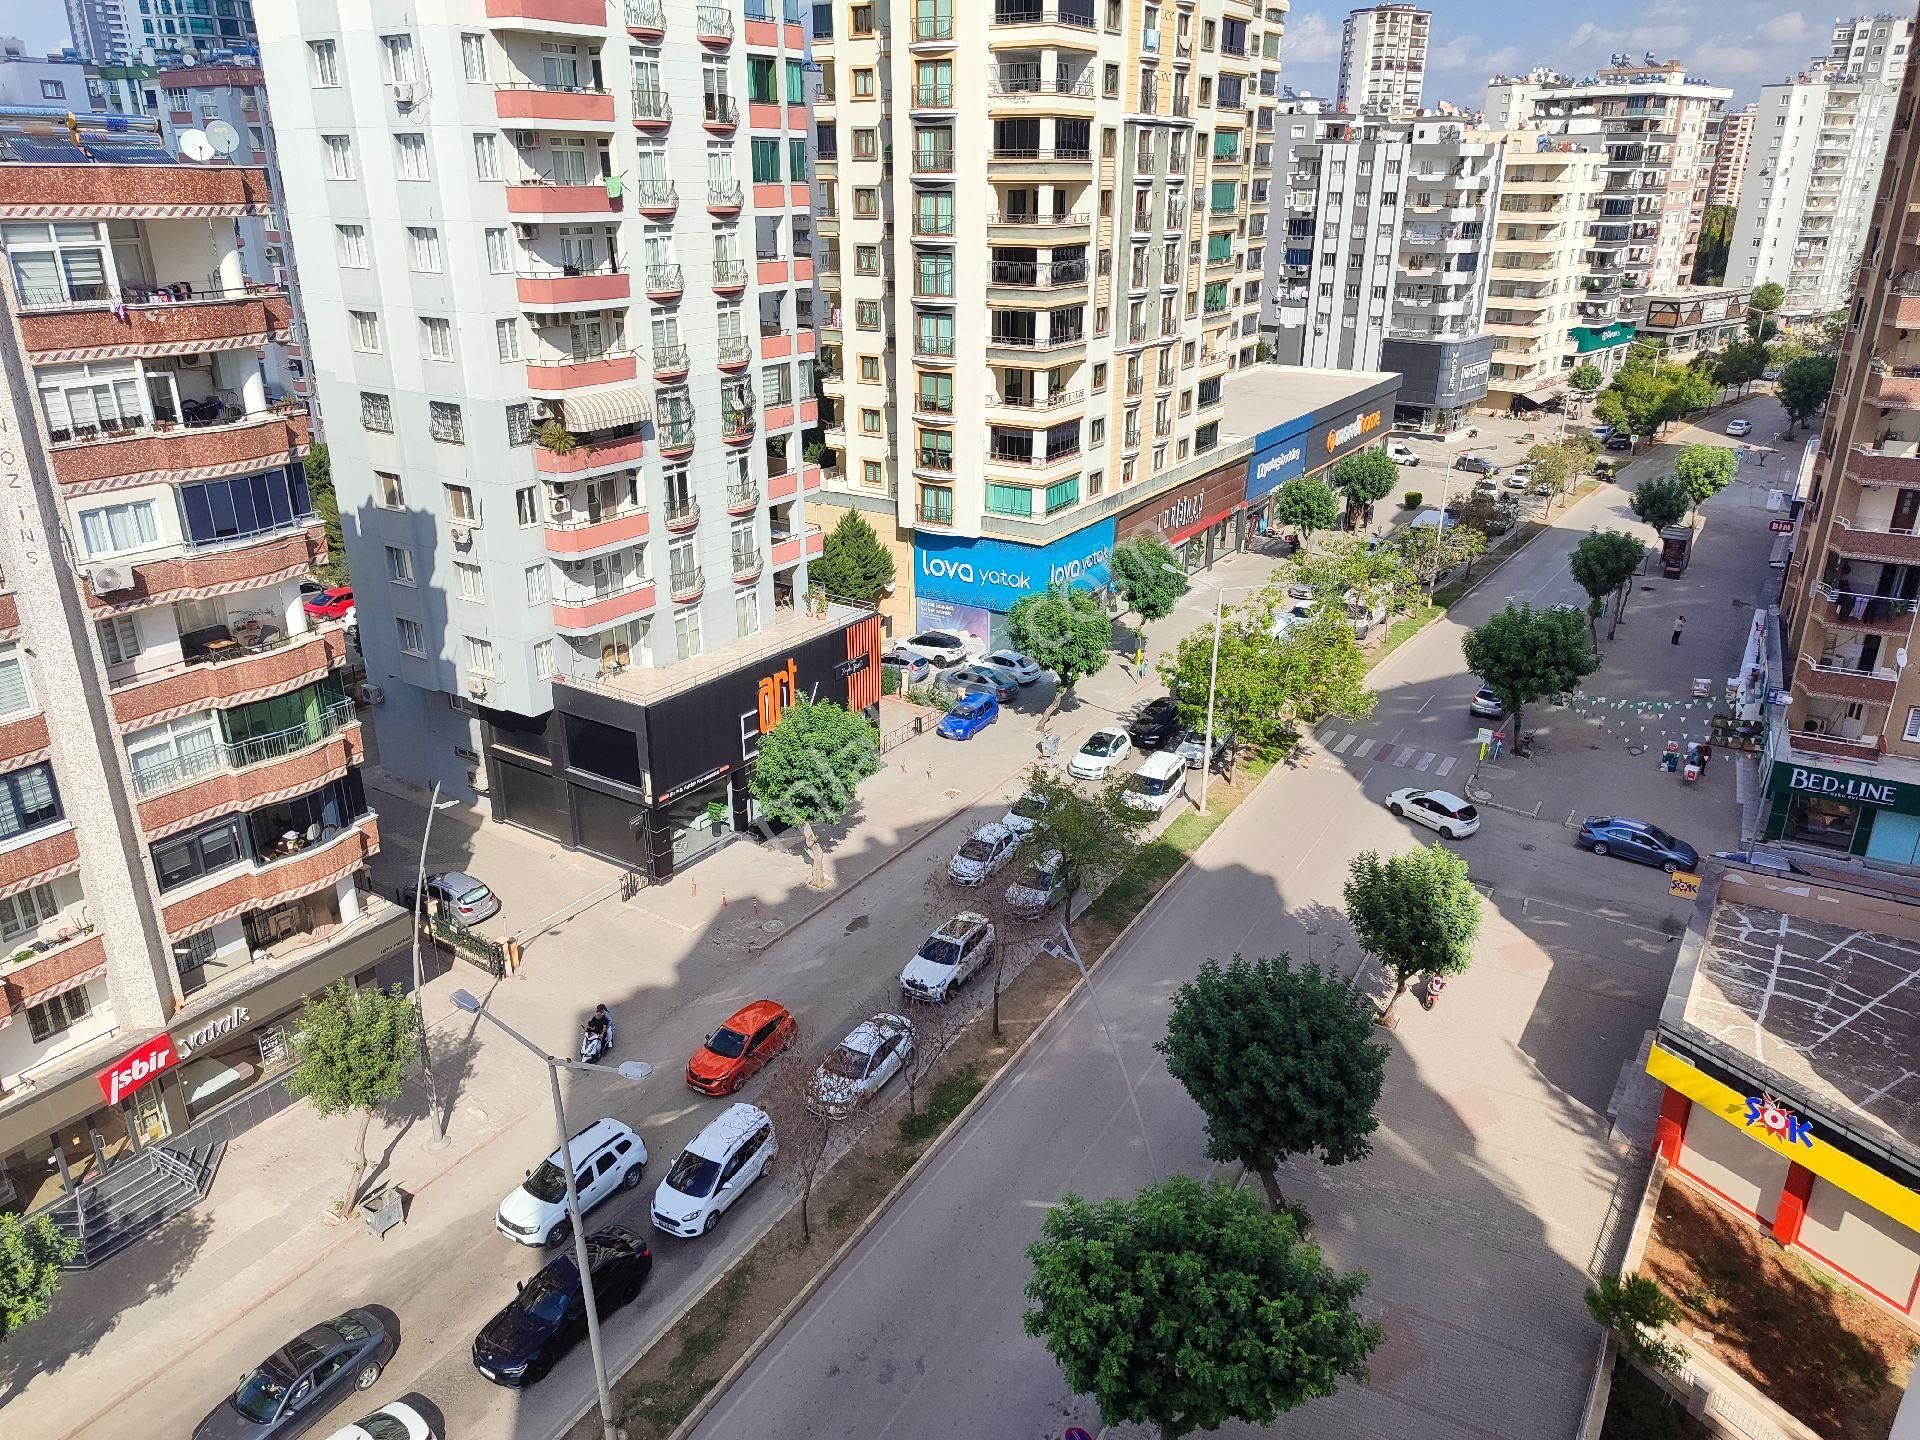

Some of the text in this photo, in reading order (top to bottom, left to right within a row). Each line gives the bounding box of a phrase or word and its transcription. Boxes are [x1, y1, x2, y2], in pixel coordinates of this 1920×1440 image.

[1448, 351, 1460, 390] MASTER
[922, 550, 1031, 591] lova yatak
[1050, 545, 1109, 586] lova yatak
[1788, 767, 1897, 803] BED LINE
[179, 1006, 251, 1060] yatak
